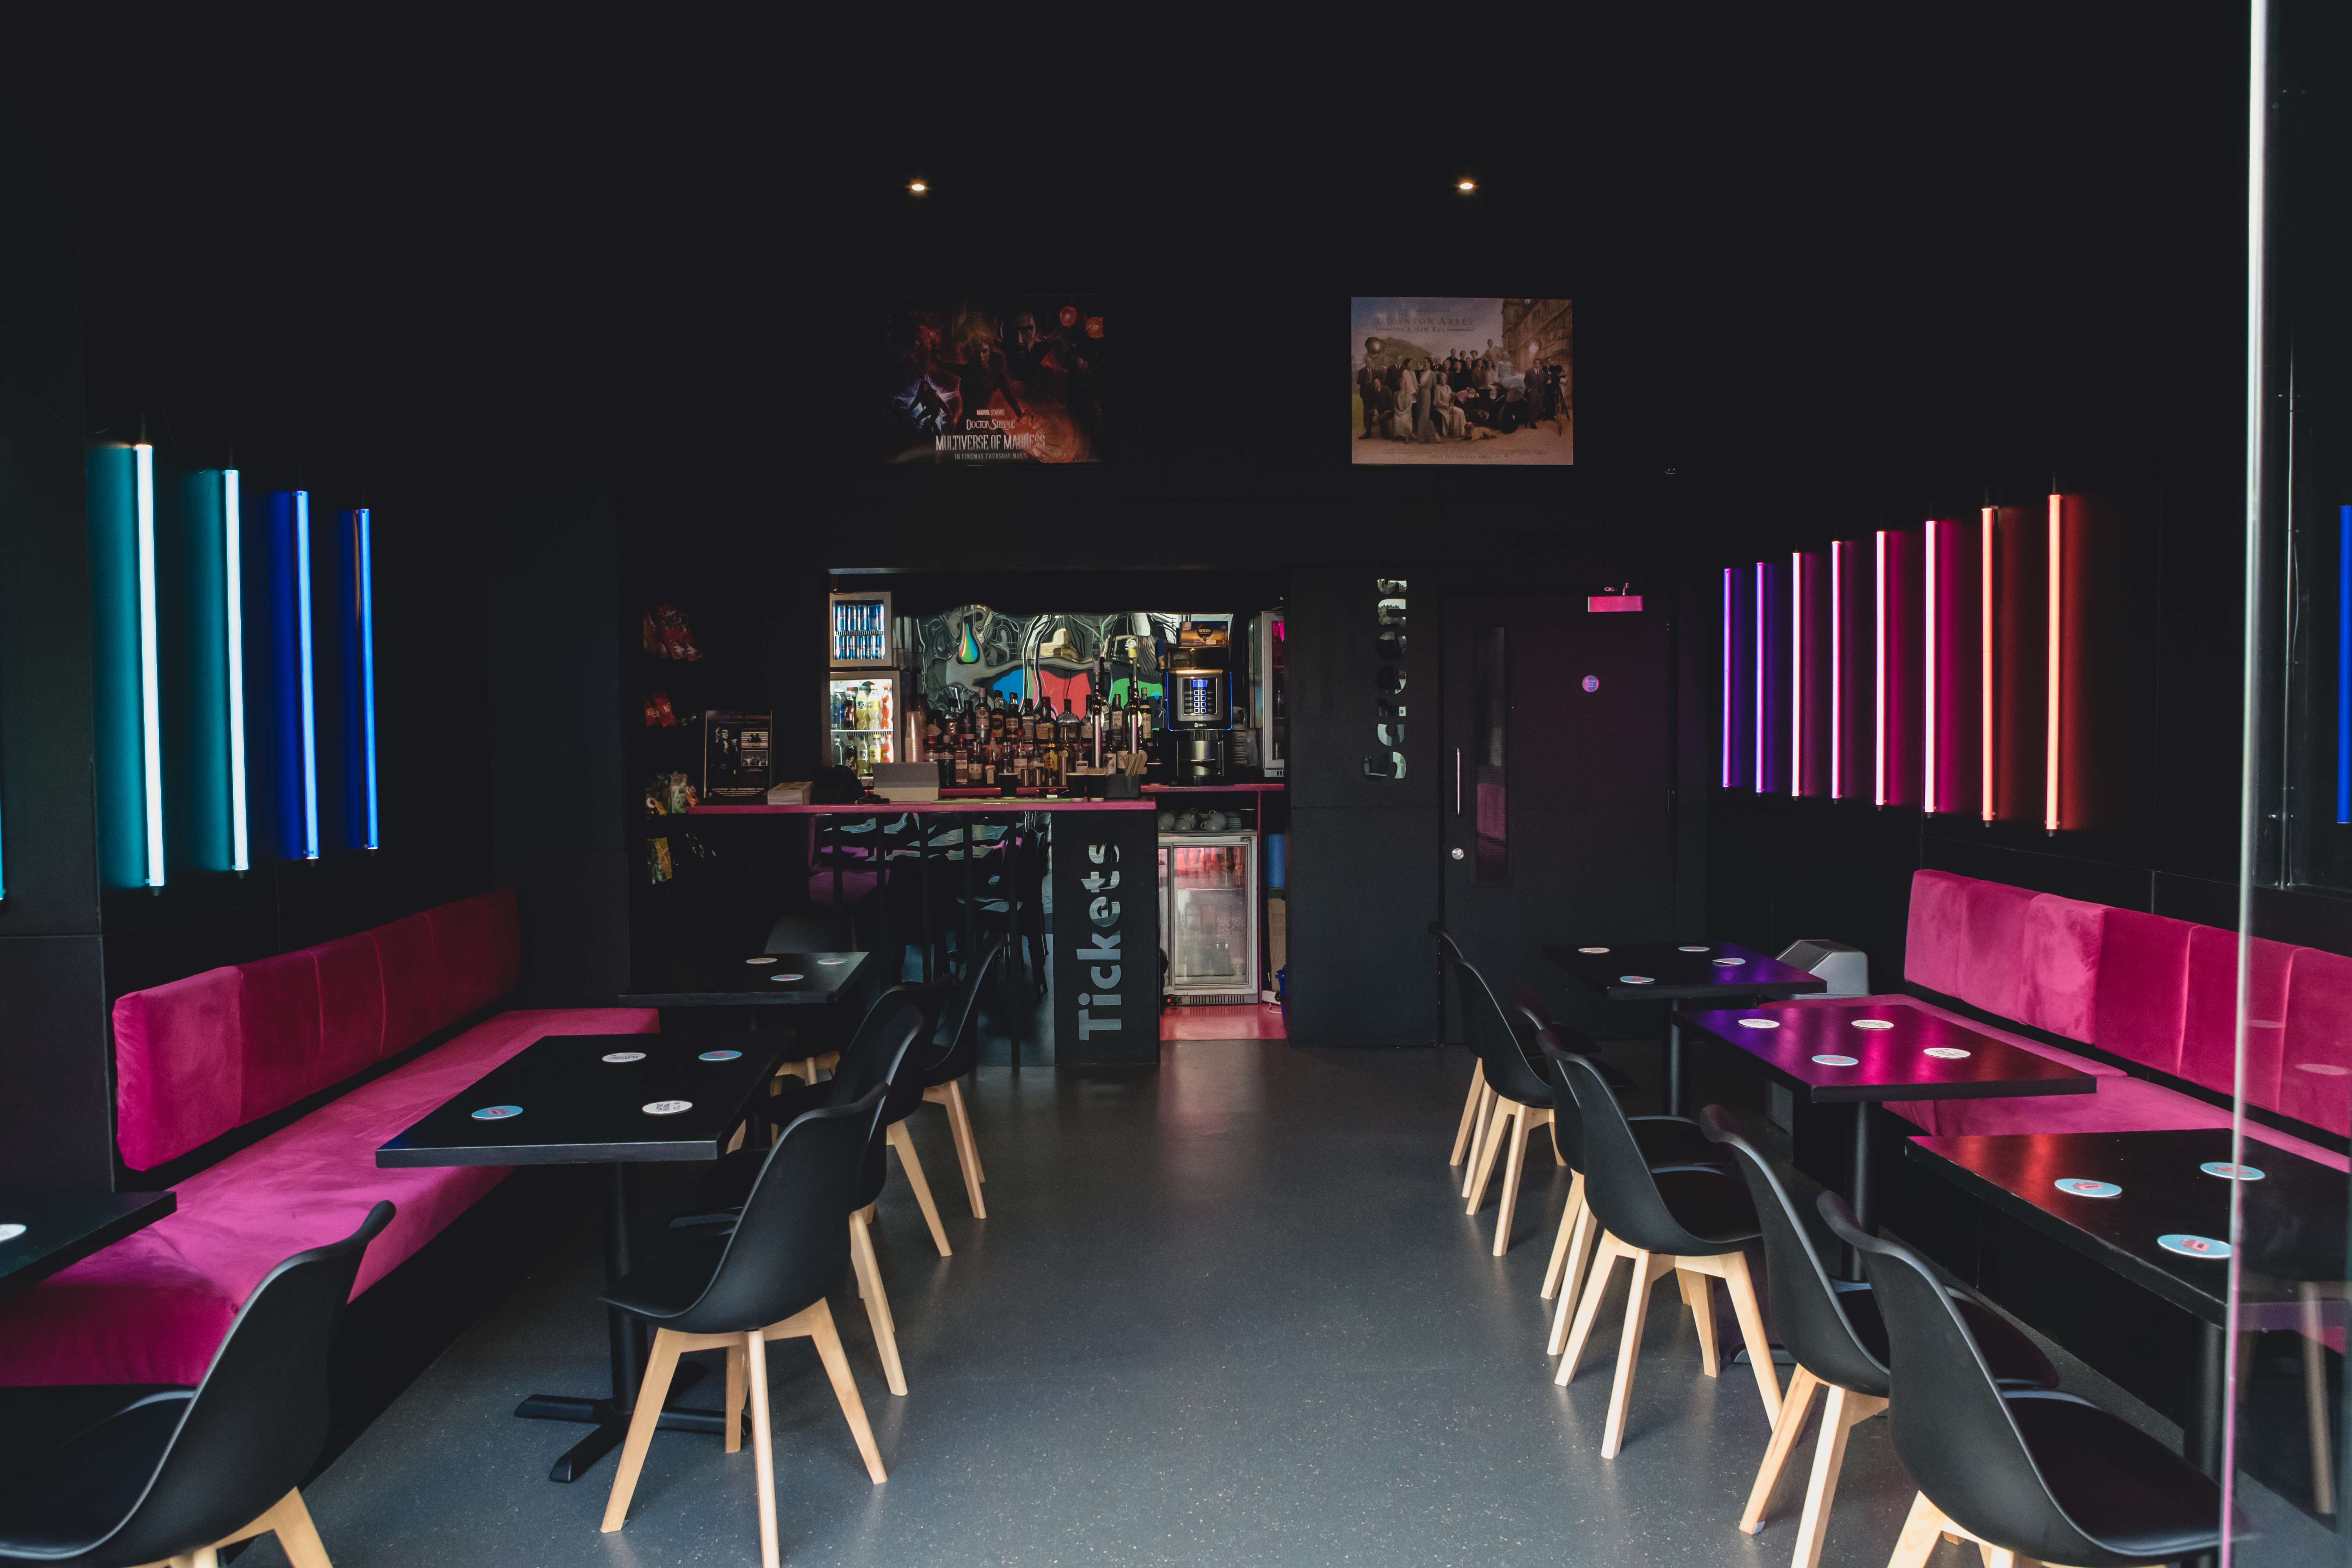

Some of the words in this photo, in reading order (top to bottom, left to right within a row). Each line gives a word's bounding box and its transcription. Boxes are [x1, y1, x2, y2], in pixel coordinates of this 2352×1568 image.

[1439, 317, 1474, 325] ABBEY
[936, 434, 989, 451] MULTIVERSE
[991, 434, 1002, 450] OF
[1004, 434, 1045, 450] MADNESS
[1363, 574, 1407, 781] Screens
[1076, 842, 1122, 1041] Tickets
